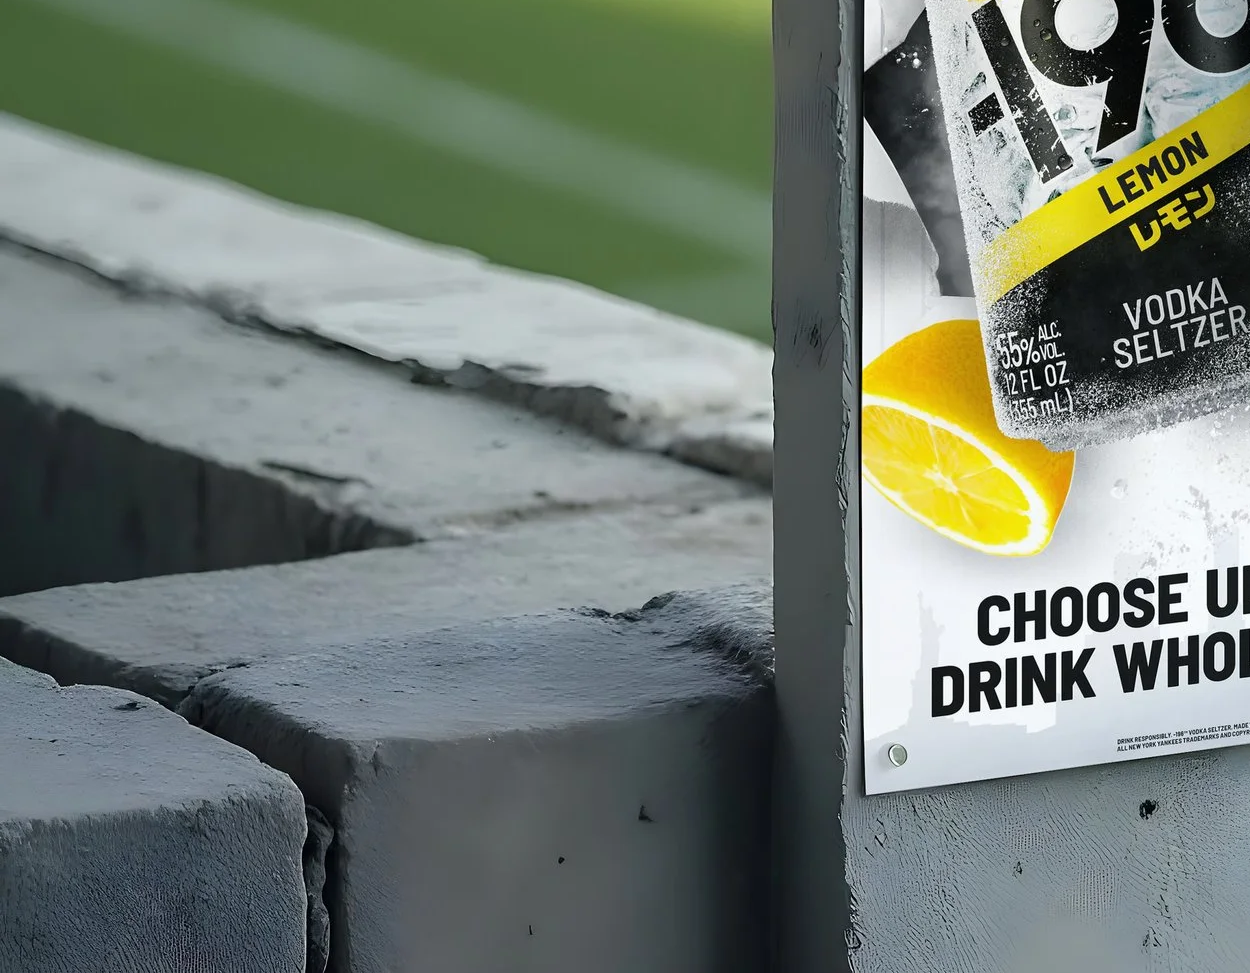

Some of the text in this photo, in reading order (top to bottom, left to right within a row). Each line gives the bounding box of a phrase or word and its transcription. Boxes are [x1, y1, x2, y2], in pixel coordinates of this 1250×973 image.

[1097, 131, 1210, 214] LEMON
[1128, 184, 1216, 252] レモン
[1123, 277, 1229, 330] VODKA
[1038, 321, 1062, 342] ALC.
[1039, 341, 1066, 361] VOL.
[1112, 304, 1249, 369] SELTZER
[1005, 360, 1070, 396] 12 FL OZ
[1040, 387, 1074, 417] mL)
[977, 572, 1190, 647] CHOOSE
[931, 648, 1097, 718] DRINK
[1117, 737, 1134, 745] DRINK
[1135, 732, 1172, 743] RESPONSIBLY.
[1234, 722, 1248, 730] MADE
[1129, 743, 1141, 751] NEW
[1142, 741, 1156, 749] YORK
[1157, 738, 1182, 747] YANKEES
[1183, 733, 1219, 744] TRADEMARKS
[1220, 731, 1231, 739] AND
